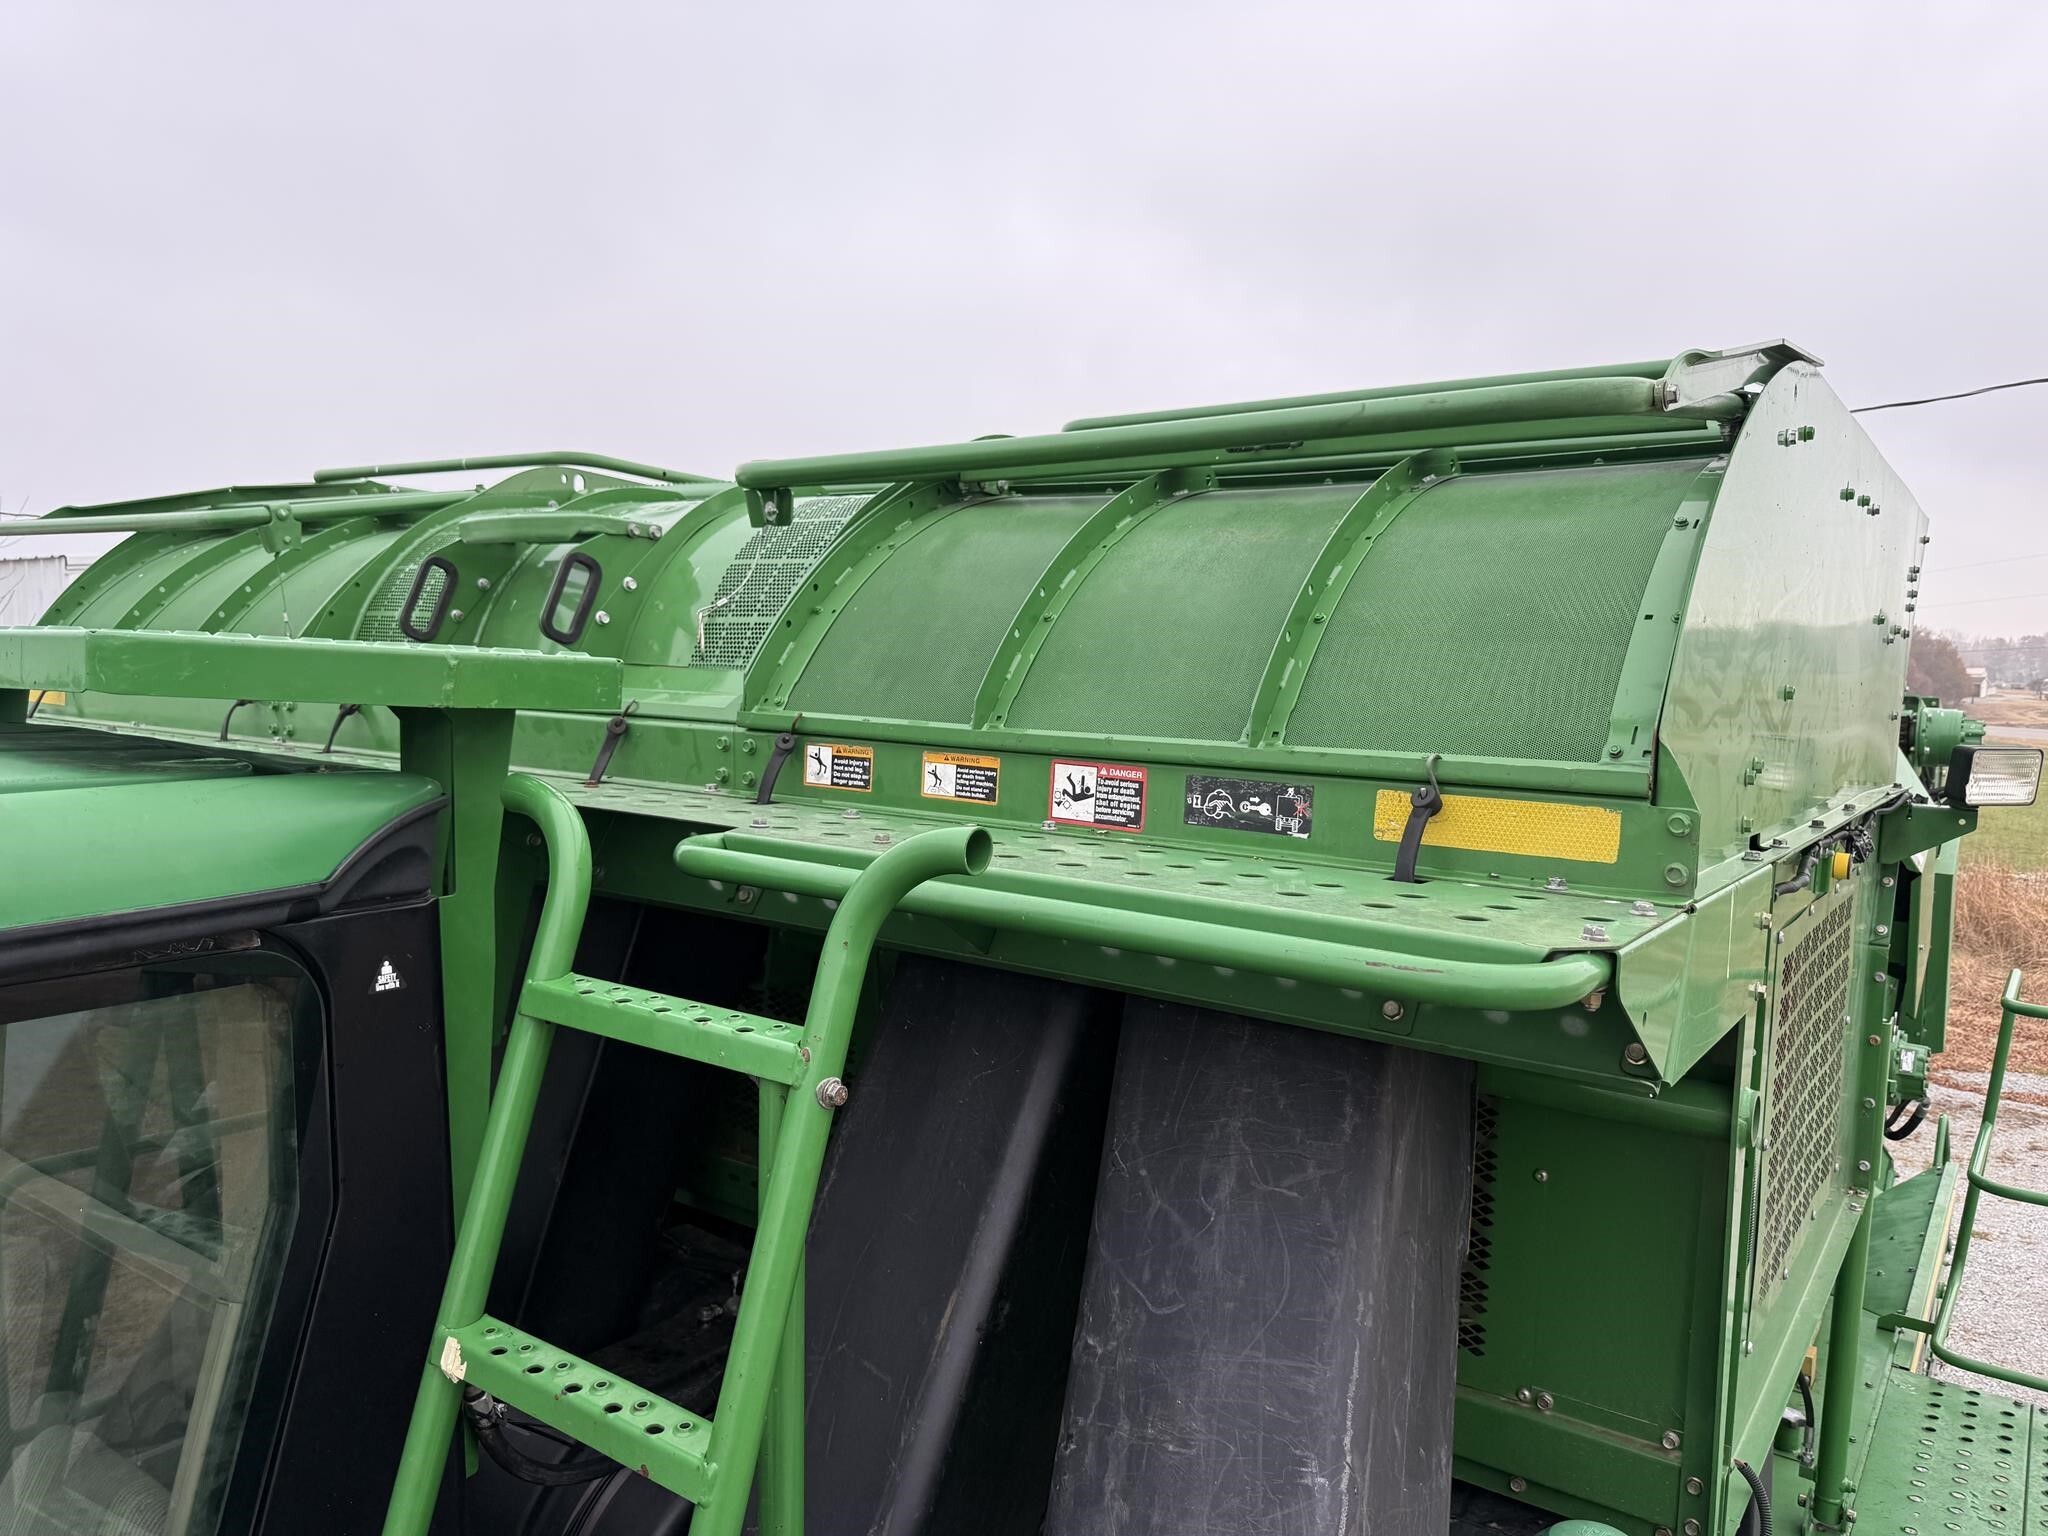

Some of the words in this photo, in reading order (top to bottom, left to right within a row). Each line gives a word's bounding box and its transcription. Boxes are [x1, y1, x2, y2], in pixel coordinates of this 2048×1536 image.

[951, 755, 980, 763] WARNING
[1110, 769, 1142, 779] DANGER
[1112, 809, 1134, 817] servicing
[1095, 814, 1128, 823] accumulator.
[378, 973, 396, 983] SAFETY
